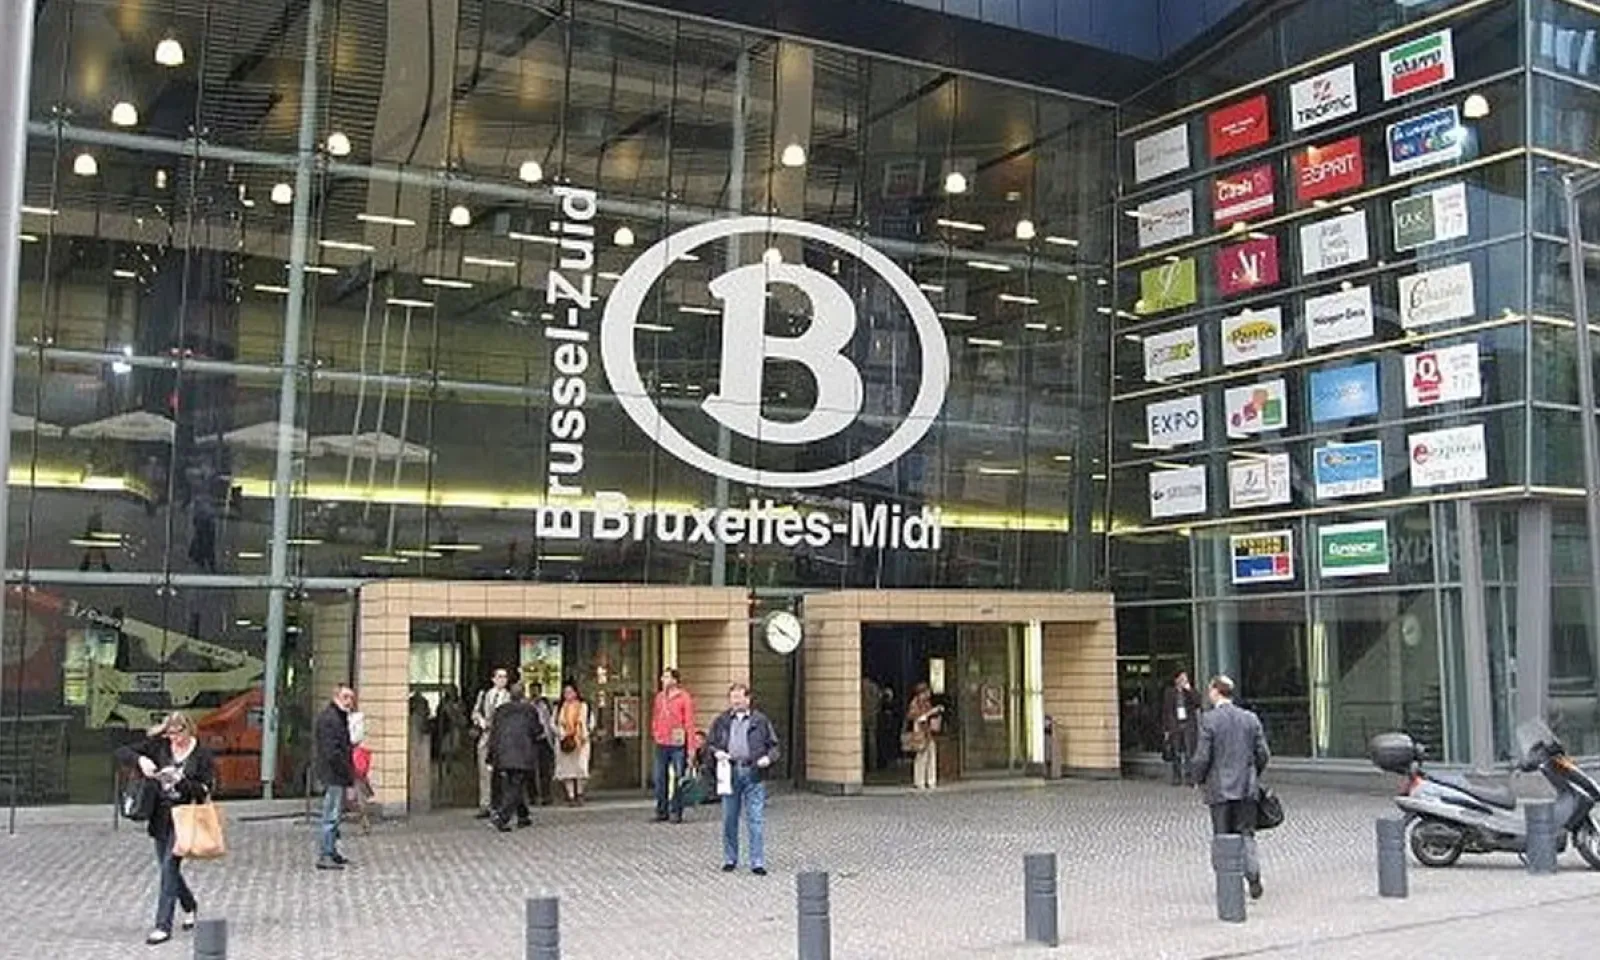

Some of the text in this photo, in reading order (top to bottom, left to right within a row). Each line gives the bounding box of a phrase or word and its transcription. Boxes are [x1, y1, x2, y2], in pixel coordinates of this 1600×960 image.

[1302, 156, 1357, 185] ESPRIT
[535, 186, 598, 540] Brussel-Zuid
[701, 262, 864, 445] B
[1151, 410, 1199, 436] EXPO
[592, 490, 942, 549] Bruxelles-Midi
